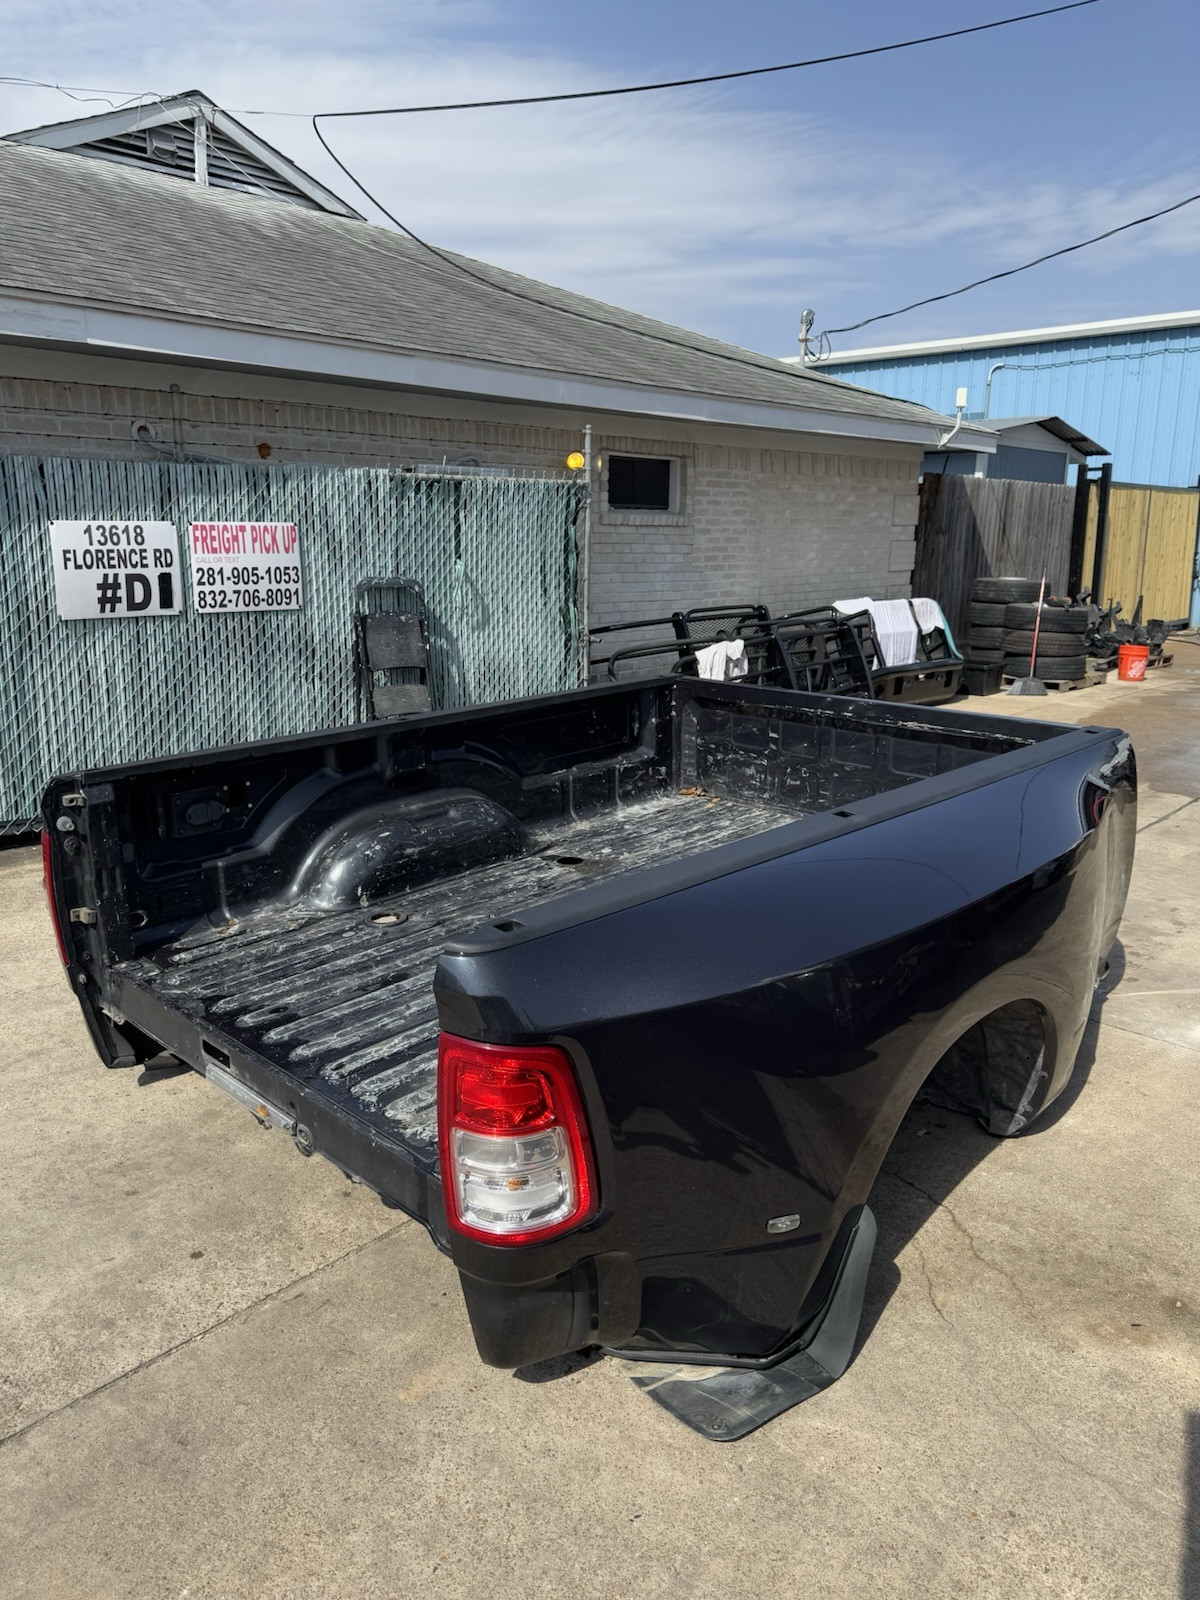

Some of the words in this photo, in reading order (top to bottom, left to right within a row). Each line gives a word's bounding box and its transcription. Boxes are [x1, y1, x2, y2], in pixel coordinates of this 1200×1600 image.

[84, 525, 145, 546] 13618
[192, 524, 246, 554] FREIGHT
[250, 525, 280, 554] PICK
[282, 525, 297, 554] UP
[63, 548, 148, 570] FLORENCE
[153, 548, 173, 568] RD
[196, 566, 300, 586] 281-905-1053
[198, 588, 300, 609] 832-706-8091
